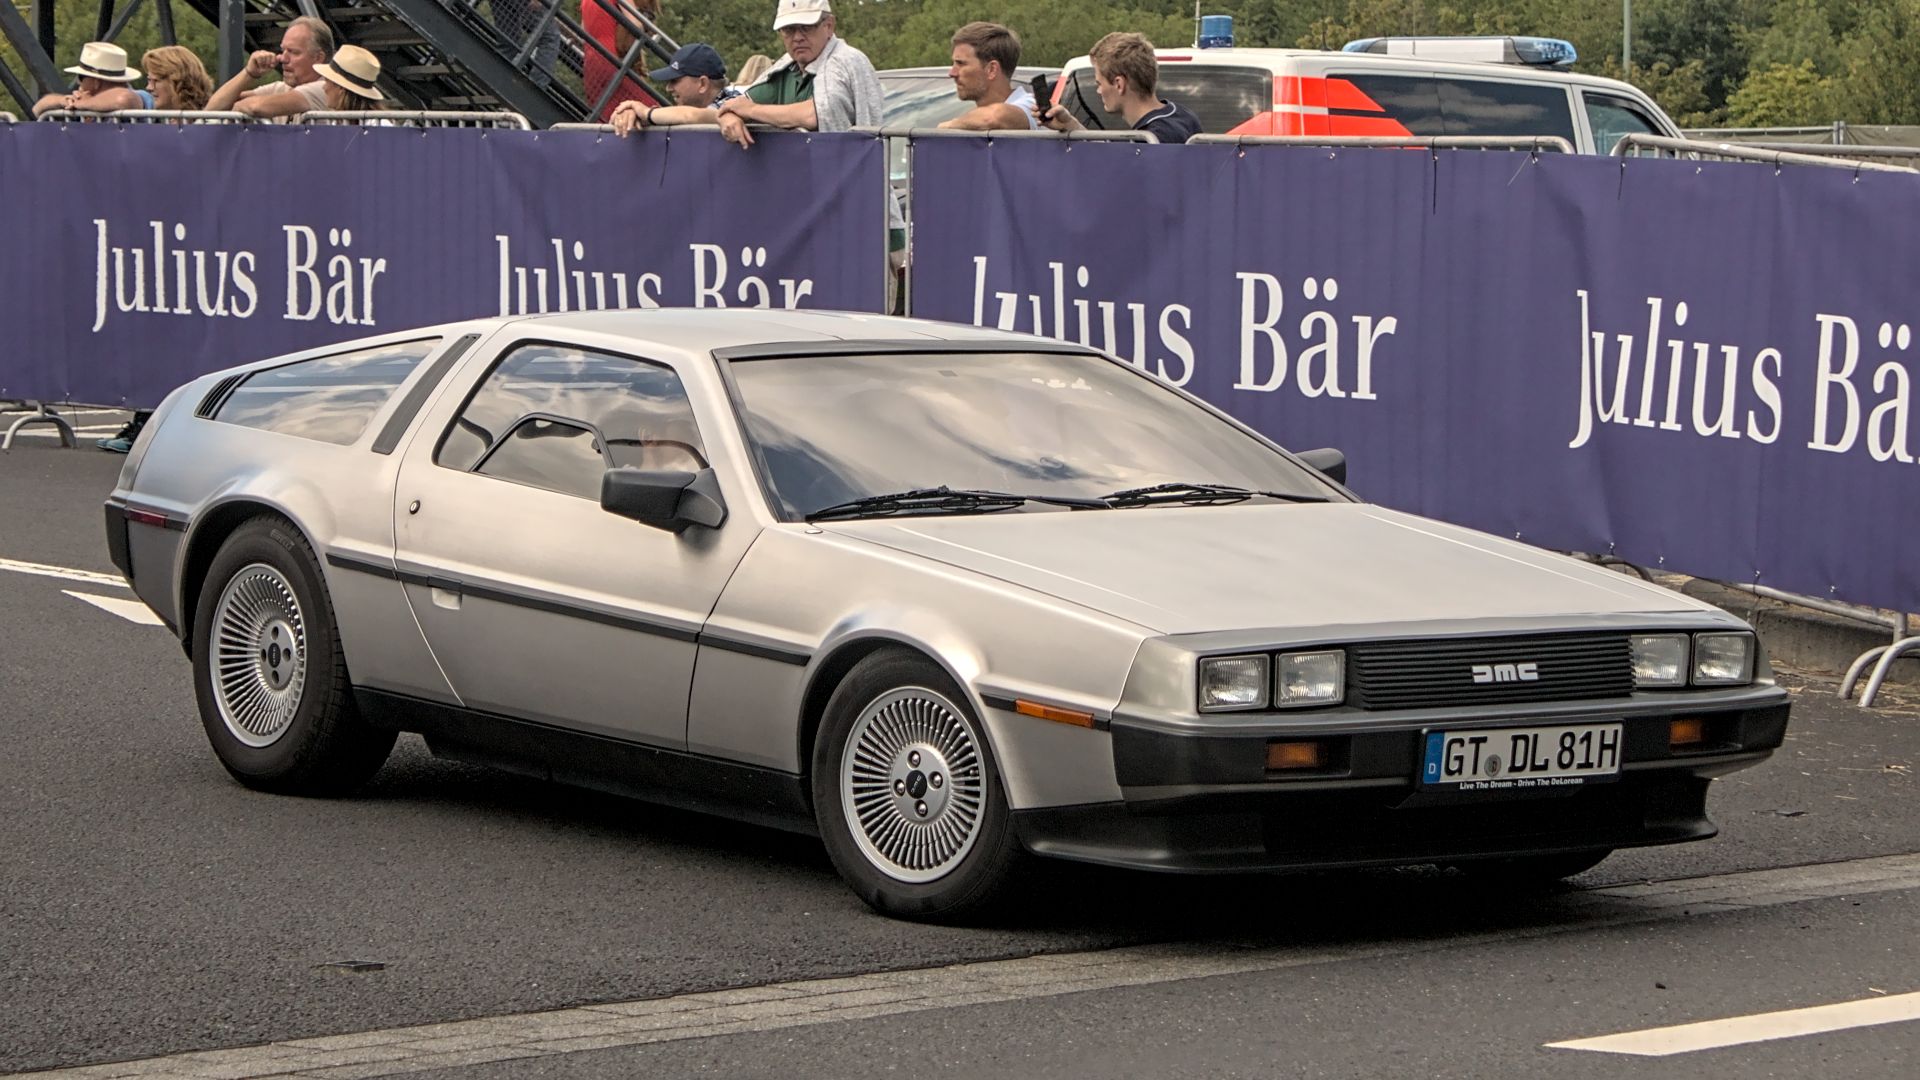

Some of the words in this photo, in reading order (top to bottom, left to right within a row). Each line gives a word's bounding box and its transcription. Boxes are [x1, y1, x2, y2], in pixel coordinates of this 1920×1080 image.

[92, 219, 257, 332] Julius
[282, 224, 386, 326] Bär
[1234, 272, 1398, 400] Bär
[1569, 289, 1782, 449] Julius
[1807, 313, 1920, 465] Bä
[1429, 763, 1436, 774] D
[1445, 736, 1488, 777] GT
[1508, 733, 1549, 773] DL
[1556, 729, 1619, 770] 81H
[1460, 781, 1475, 790] Live
[1476, 780, 1489, 789] The
[1490, 780, 1512, 789] Dream
[1518, 779, 1535, 788] Drive
[1537, 778, 1550, 786] The
[1551, 777, 1583, 786] DeLorean
